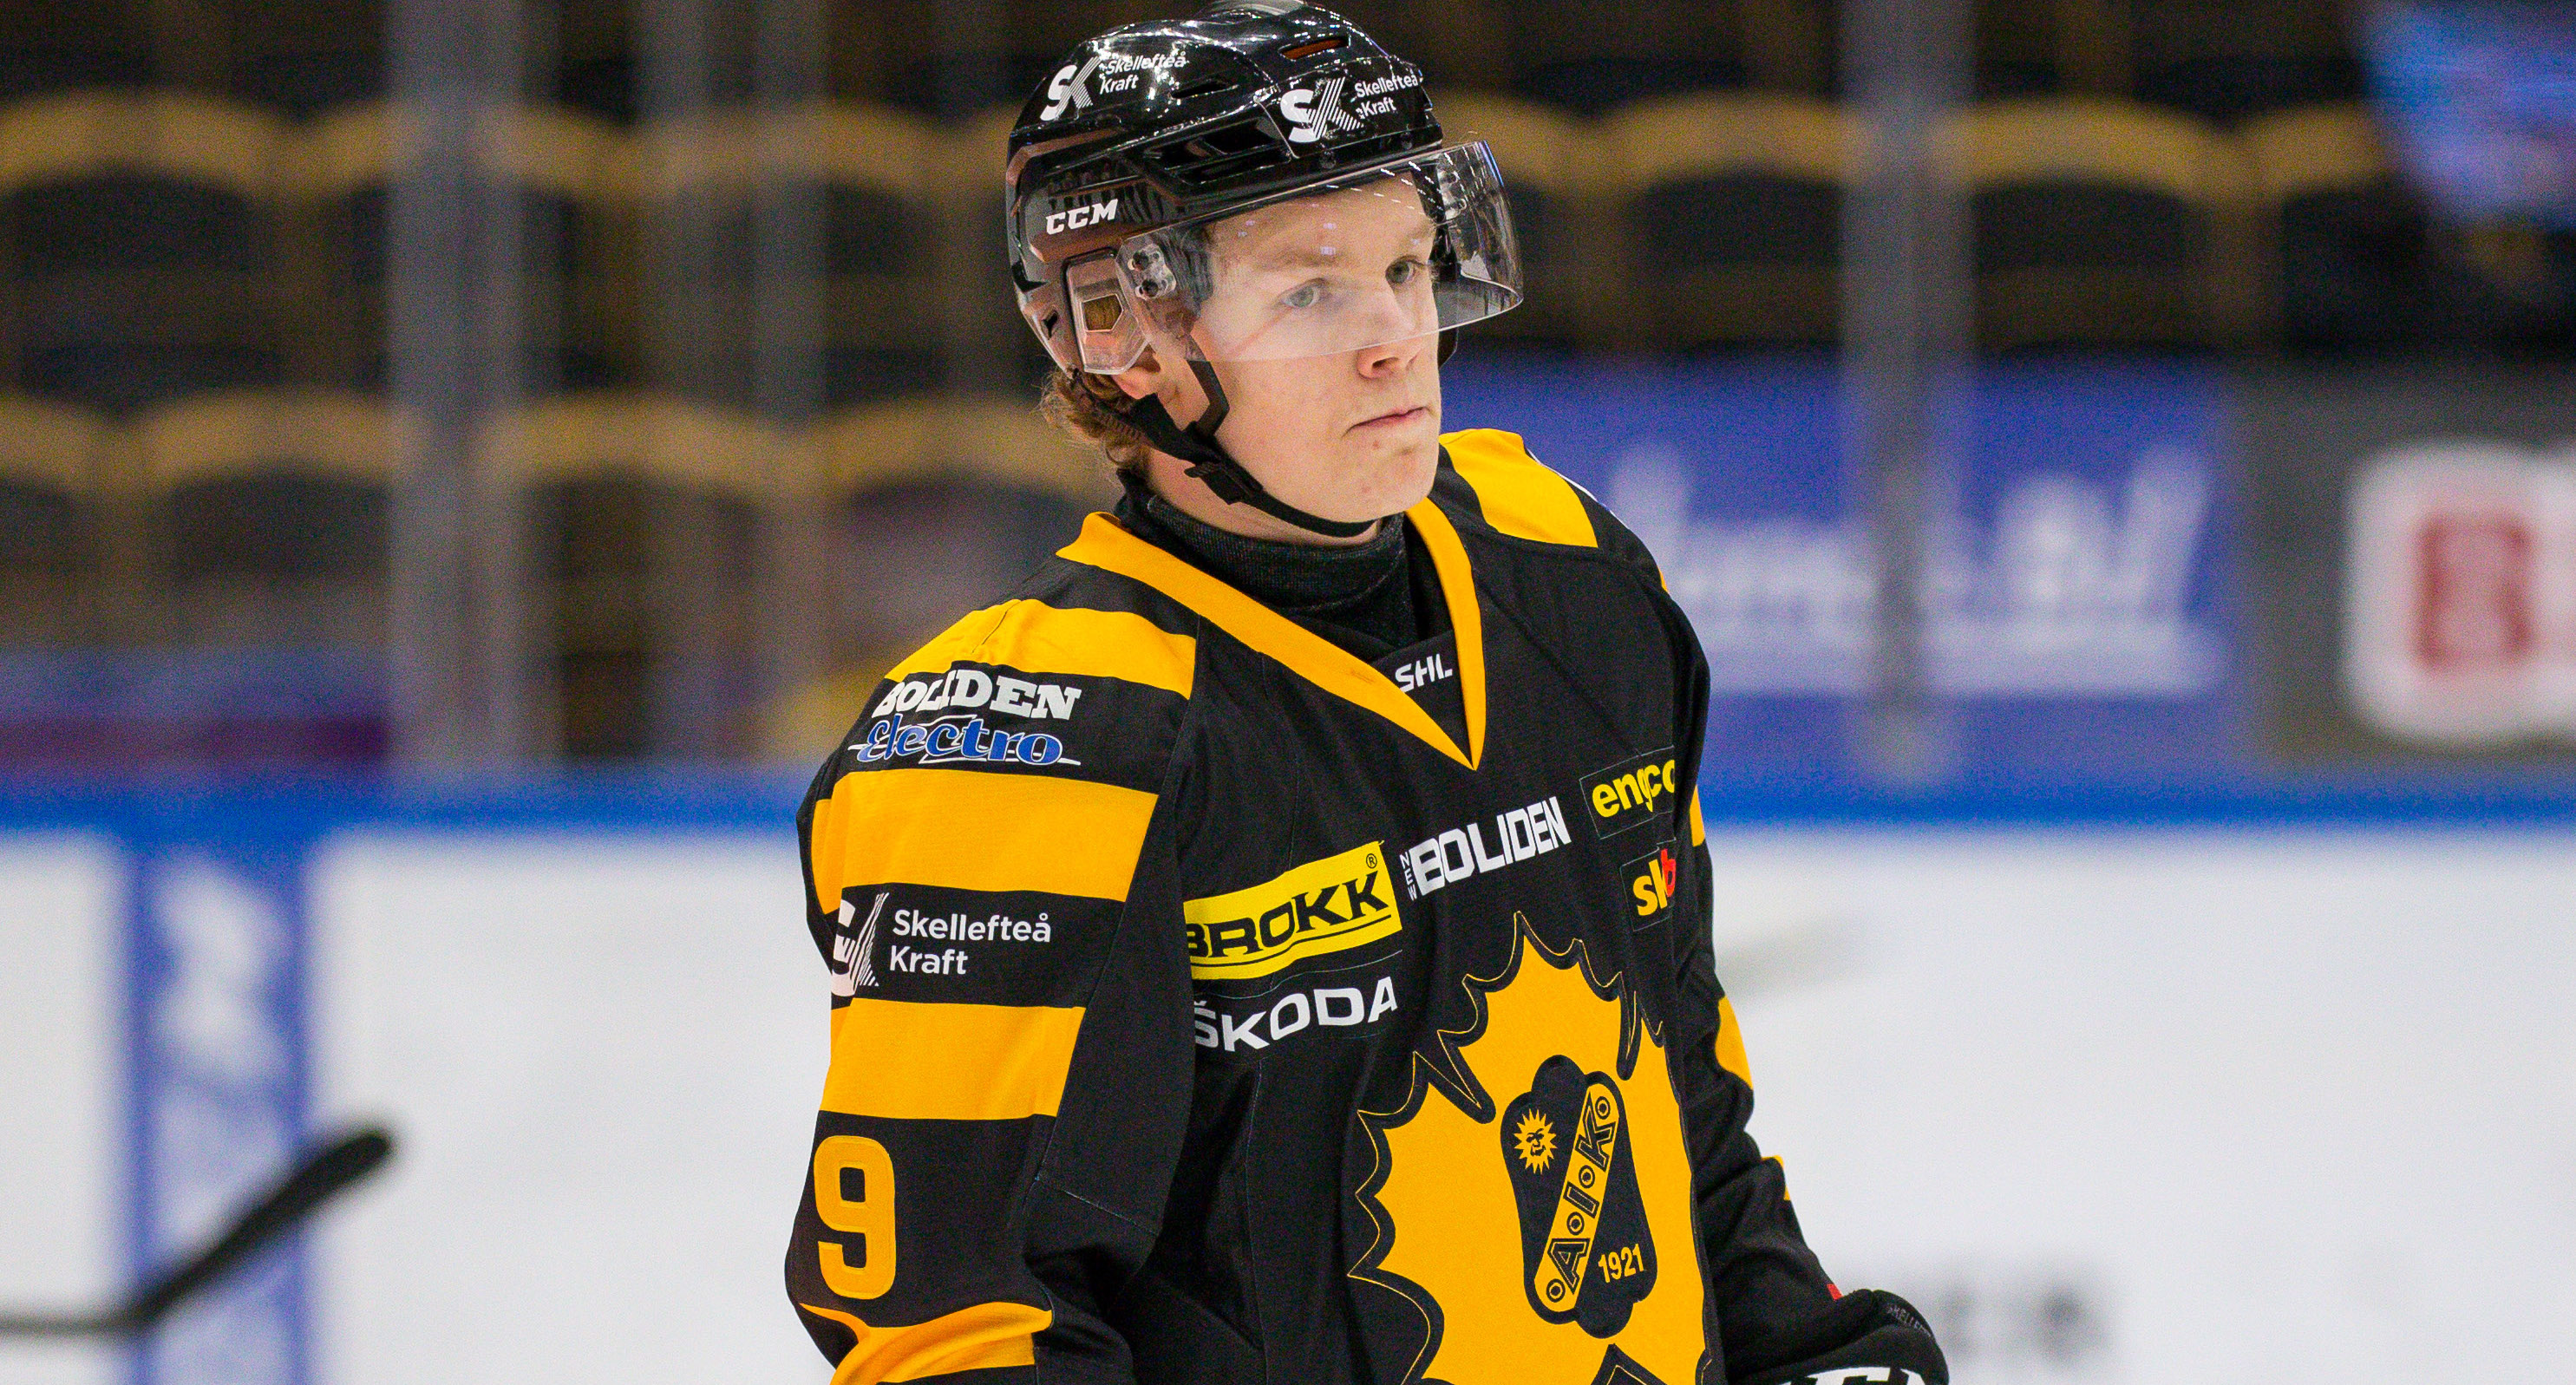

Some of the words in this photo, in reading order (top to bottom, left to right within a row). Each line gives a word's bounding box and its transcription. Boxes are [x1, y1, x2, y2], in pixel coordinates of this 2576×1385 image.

[1099, 74, 1140, 95] Kraft
[1359, 96, 1397, 120] Kraft
[1046, 199, 1119, 235] CCM
[1395, 653, 1453, 694] SHL
[872, 669, 1082, 721] BOLIDEN
[857, 713, 1063, 766] Electro
[1399, 851, 1418, 901] NEW
[1409, 795, 1572, 897] BOLIDEN
[892, 909, 1052, 943] Skellefteå
[1186, 870, 1389, 957] BROKK
[889, 944, 969, 976] Kraft
[1193, 976, 1398, 1053] ŠKODA
[814, 1135, 897, 1299] 9
[1598, 1243, 1644, 1284] 1921
